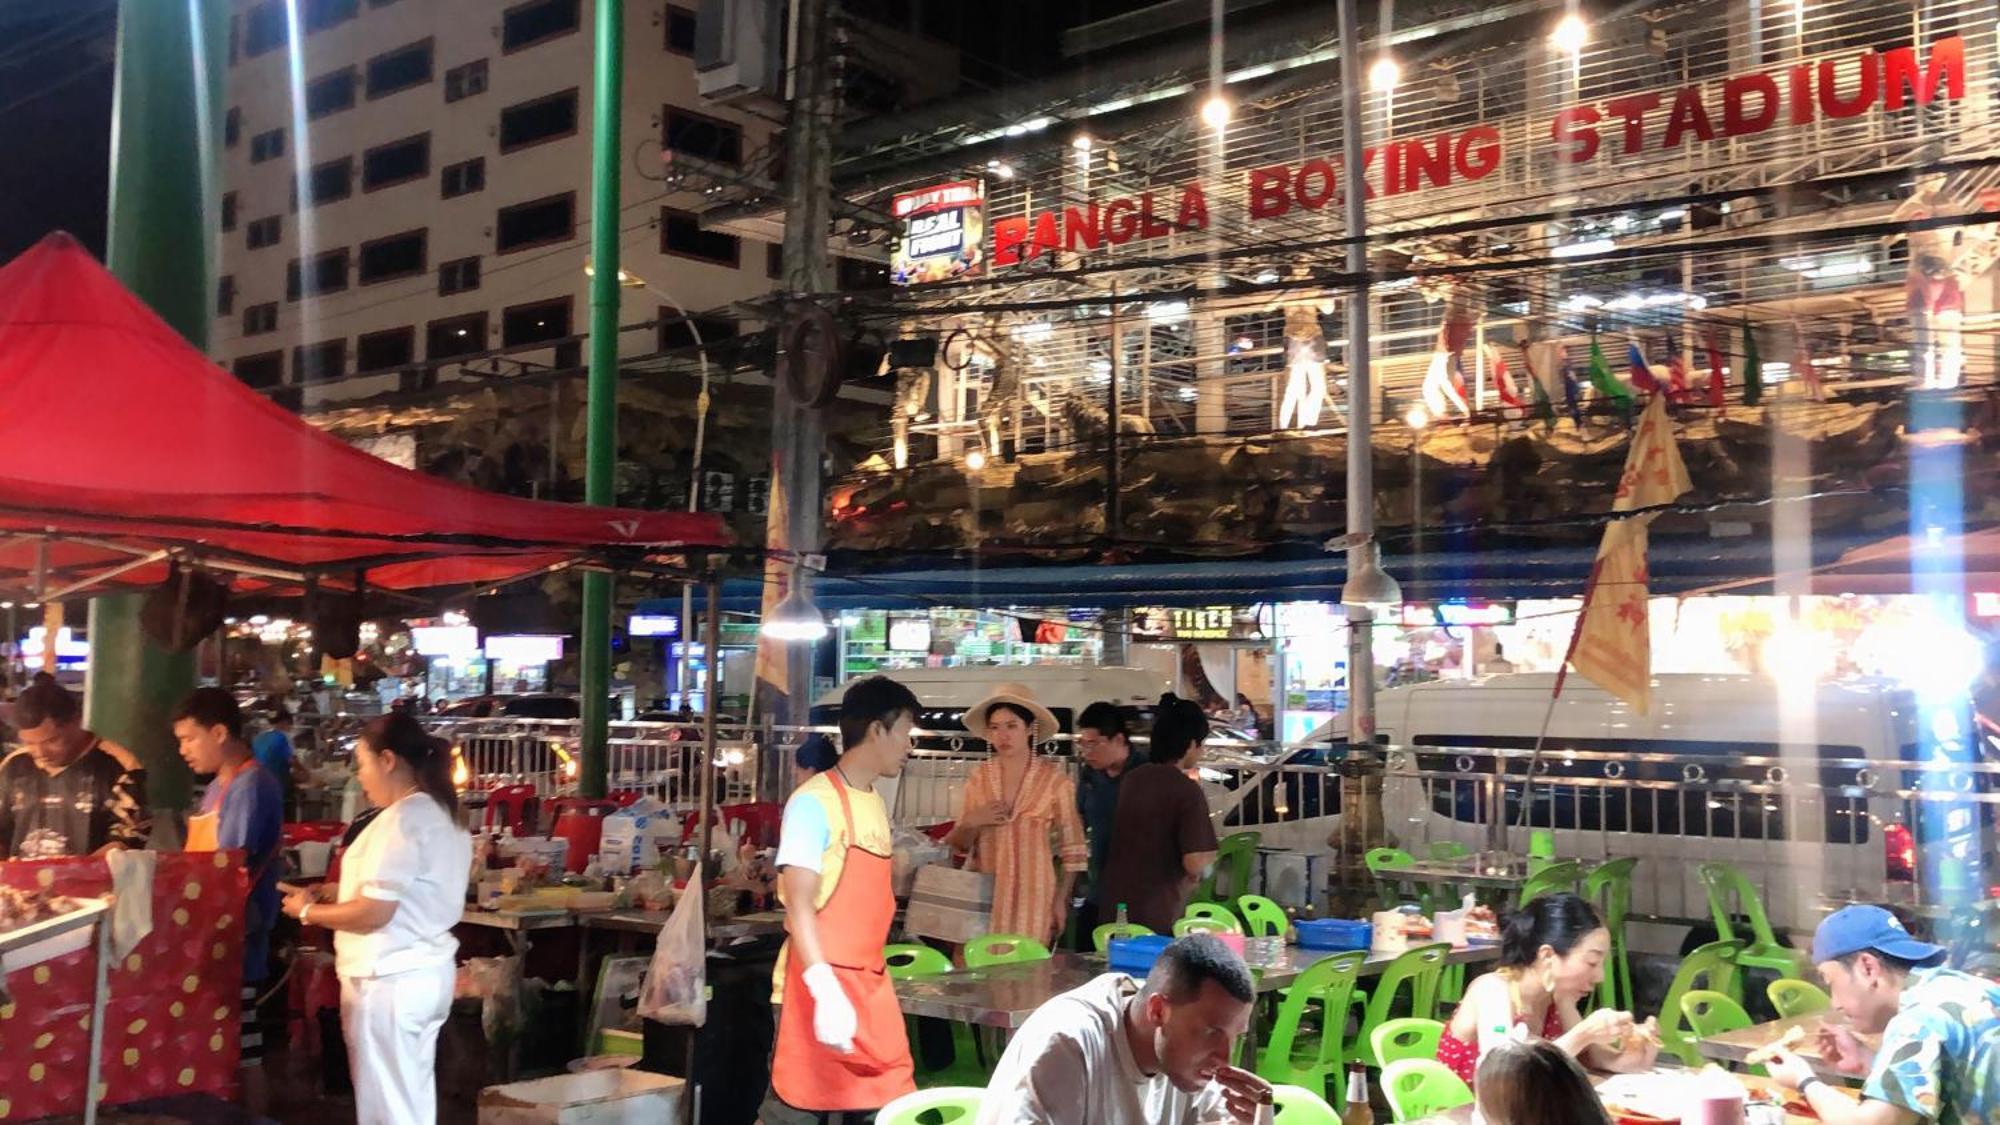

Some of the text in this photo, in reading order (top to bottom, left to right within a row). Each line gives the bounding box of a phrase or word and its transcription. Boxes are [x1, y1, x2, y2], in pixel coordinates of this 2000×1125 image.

[993, 37, 1966, 265] BANGLA BOXING STADIUM
